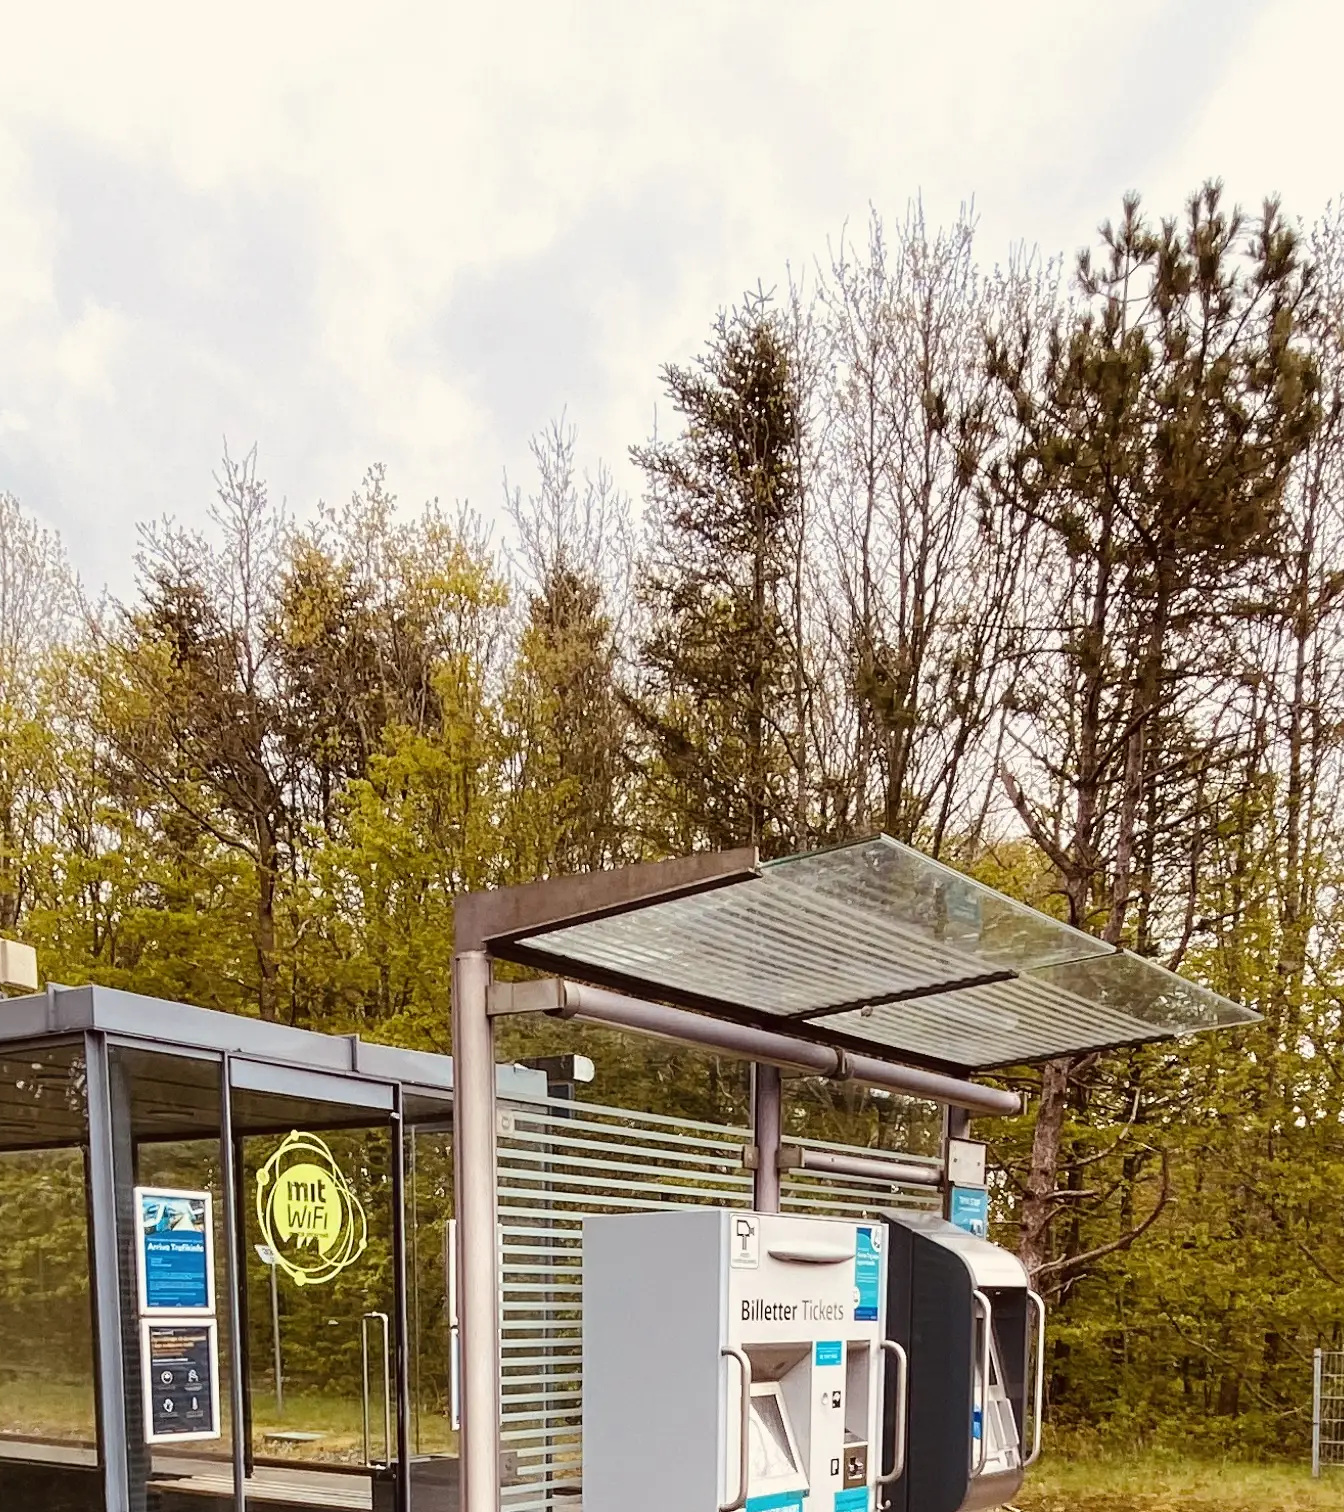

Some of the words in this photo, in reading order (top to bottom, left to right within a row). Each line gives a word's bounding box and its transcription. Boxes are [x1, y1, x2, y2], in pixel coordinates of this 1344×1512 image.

[287, 1179, 326, 1202] mit
[287, 1204, 328, 1229] WiFi
[147, 1242, 170, 1252] Arriva
[741, 1299, 797, 1321] Billetter
[802, 1299, 844, 1321] Tickets
